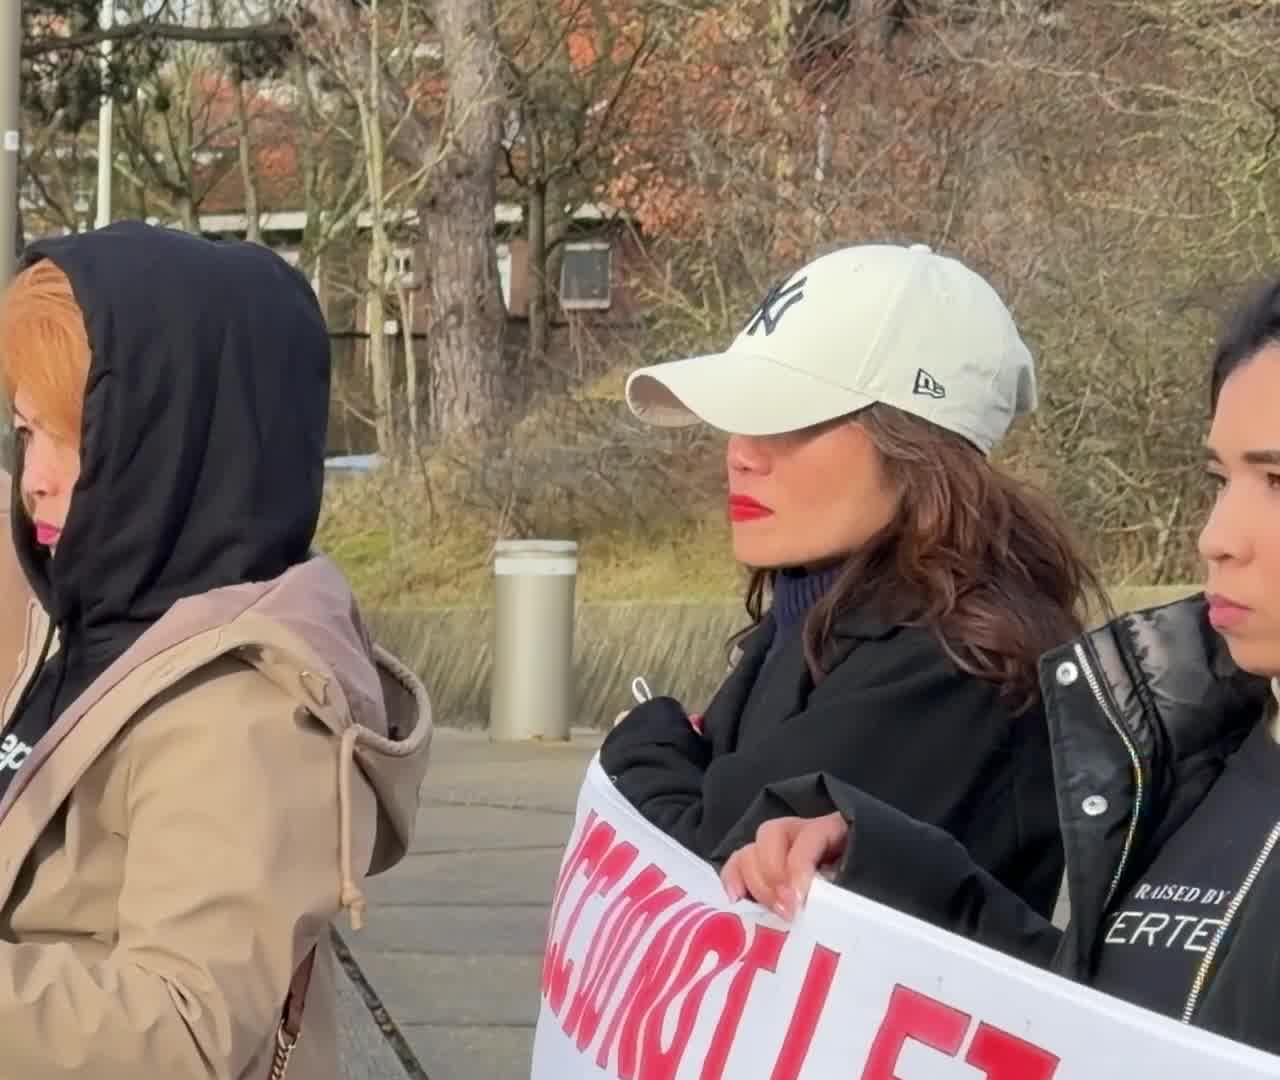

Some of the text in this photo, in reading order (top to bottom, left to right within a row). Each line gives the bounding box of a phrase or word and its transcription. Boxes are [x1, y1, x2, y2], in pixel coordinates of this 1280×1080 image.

[1134, 883, 1231, 905] RAISED BY
[1104, 911, 1225, 952] ERTE
